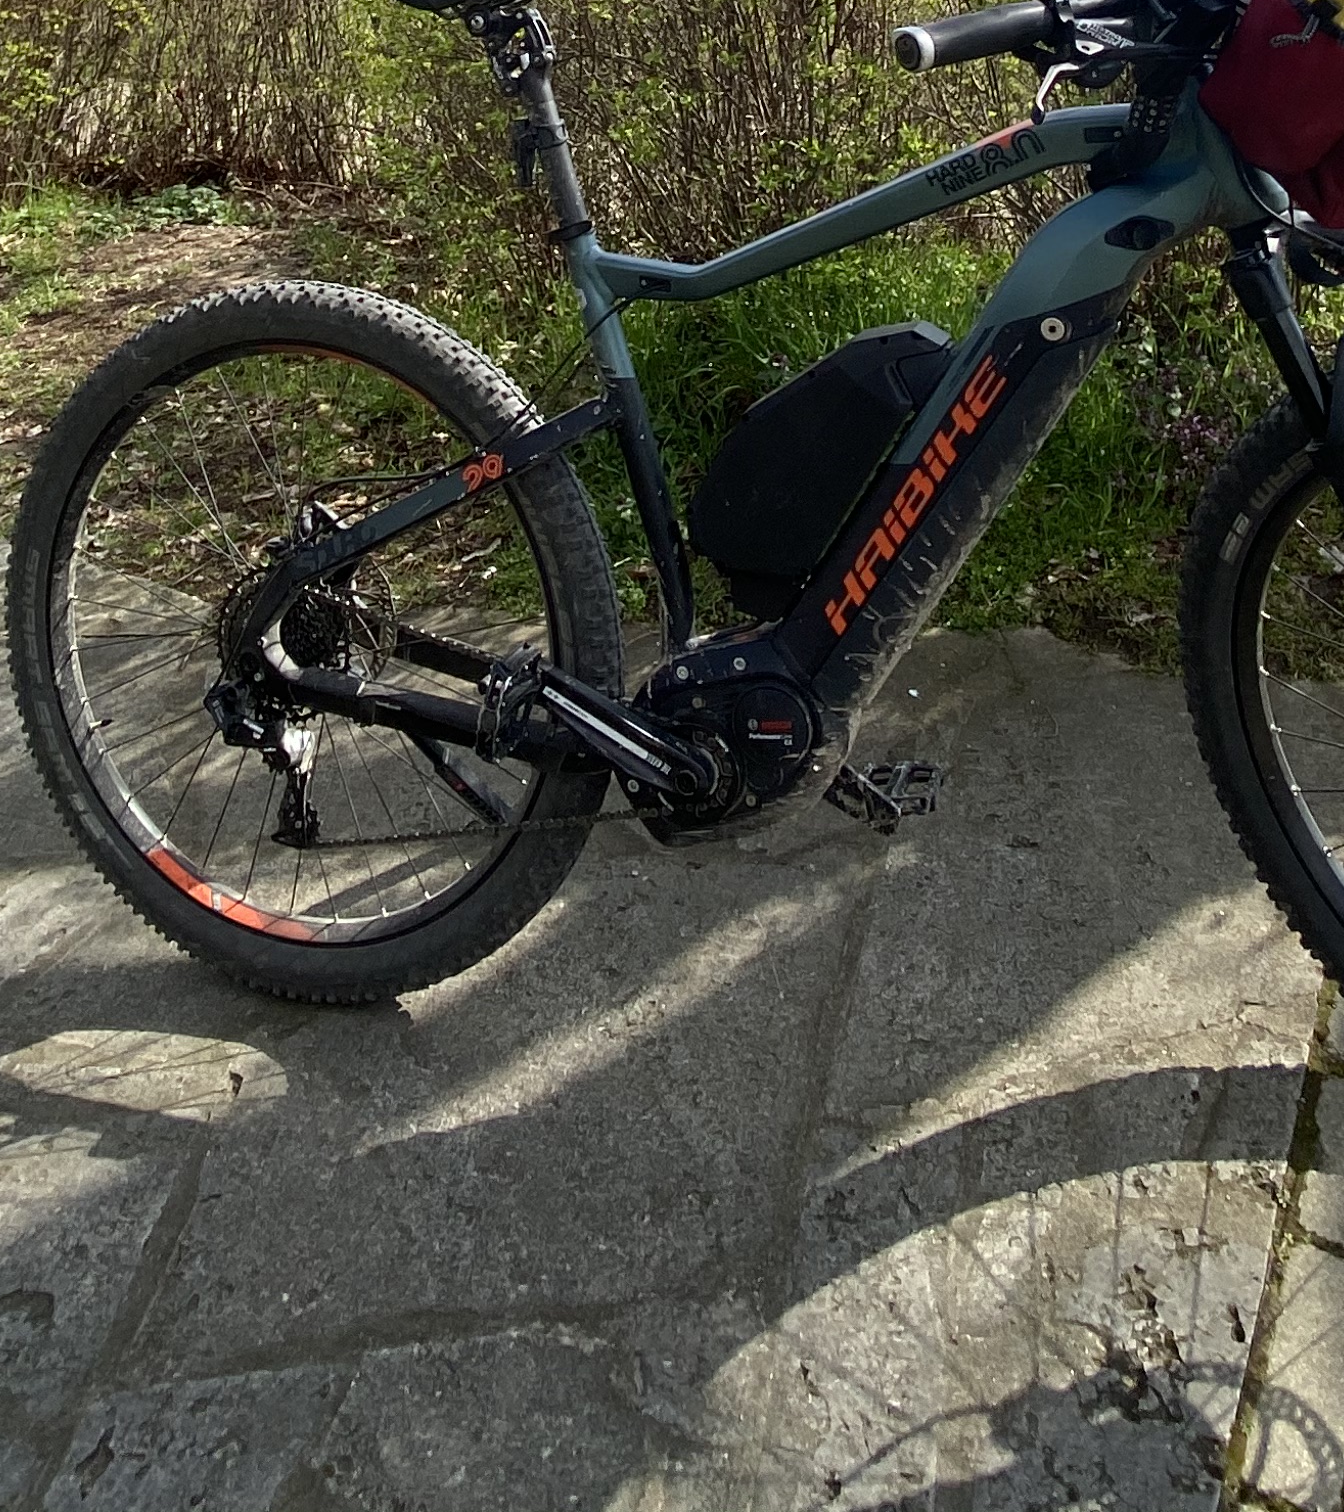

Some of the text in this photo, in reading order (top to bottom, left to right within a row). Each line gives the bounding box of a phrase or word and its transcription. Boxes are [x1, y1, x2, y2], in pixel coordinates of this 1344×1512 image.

[925, 153, 976, 187] HARD
[941, 166, 988, 196] NINE
[462, 454, 505, 493] 29
